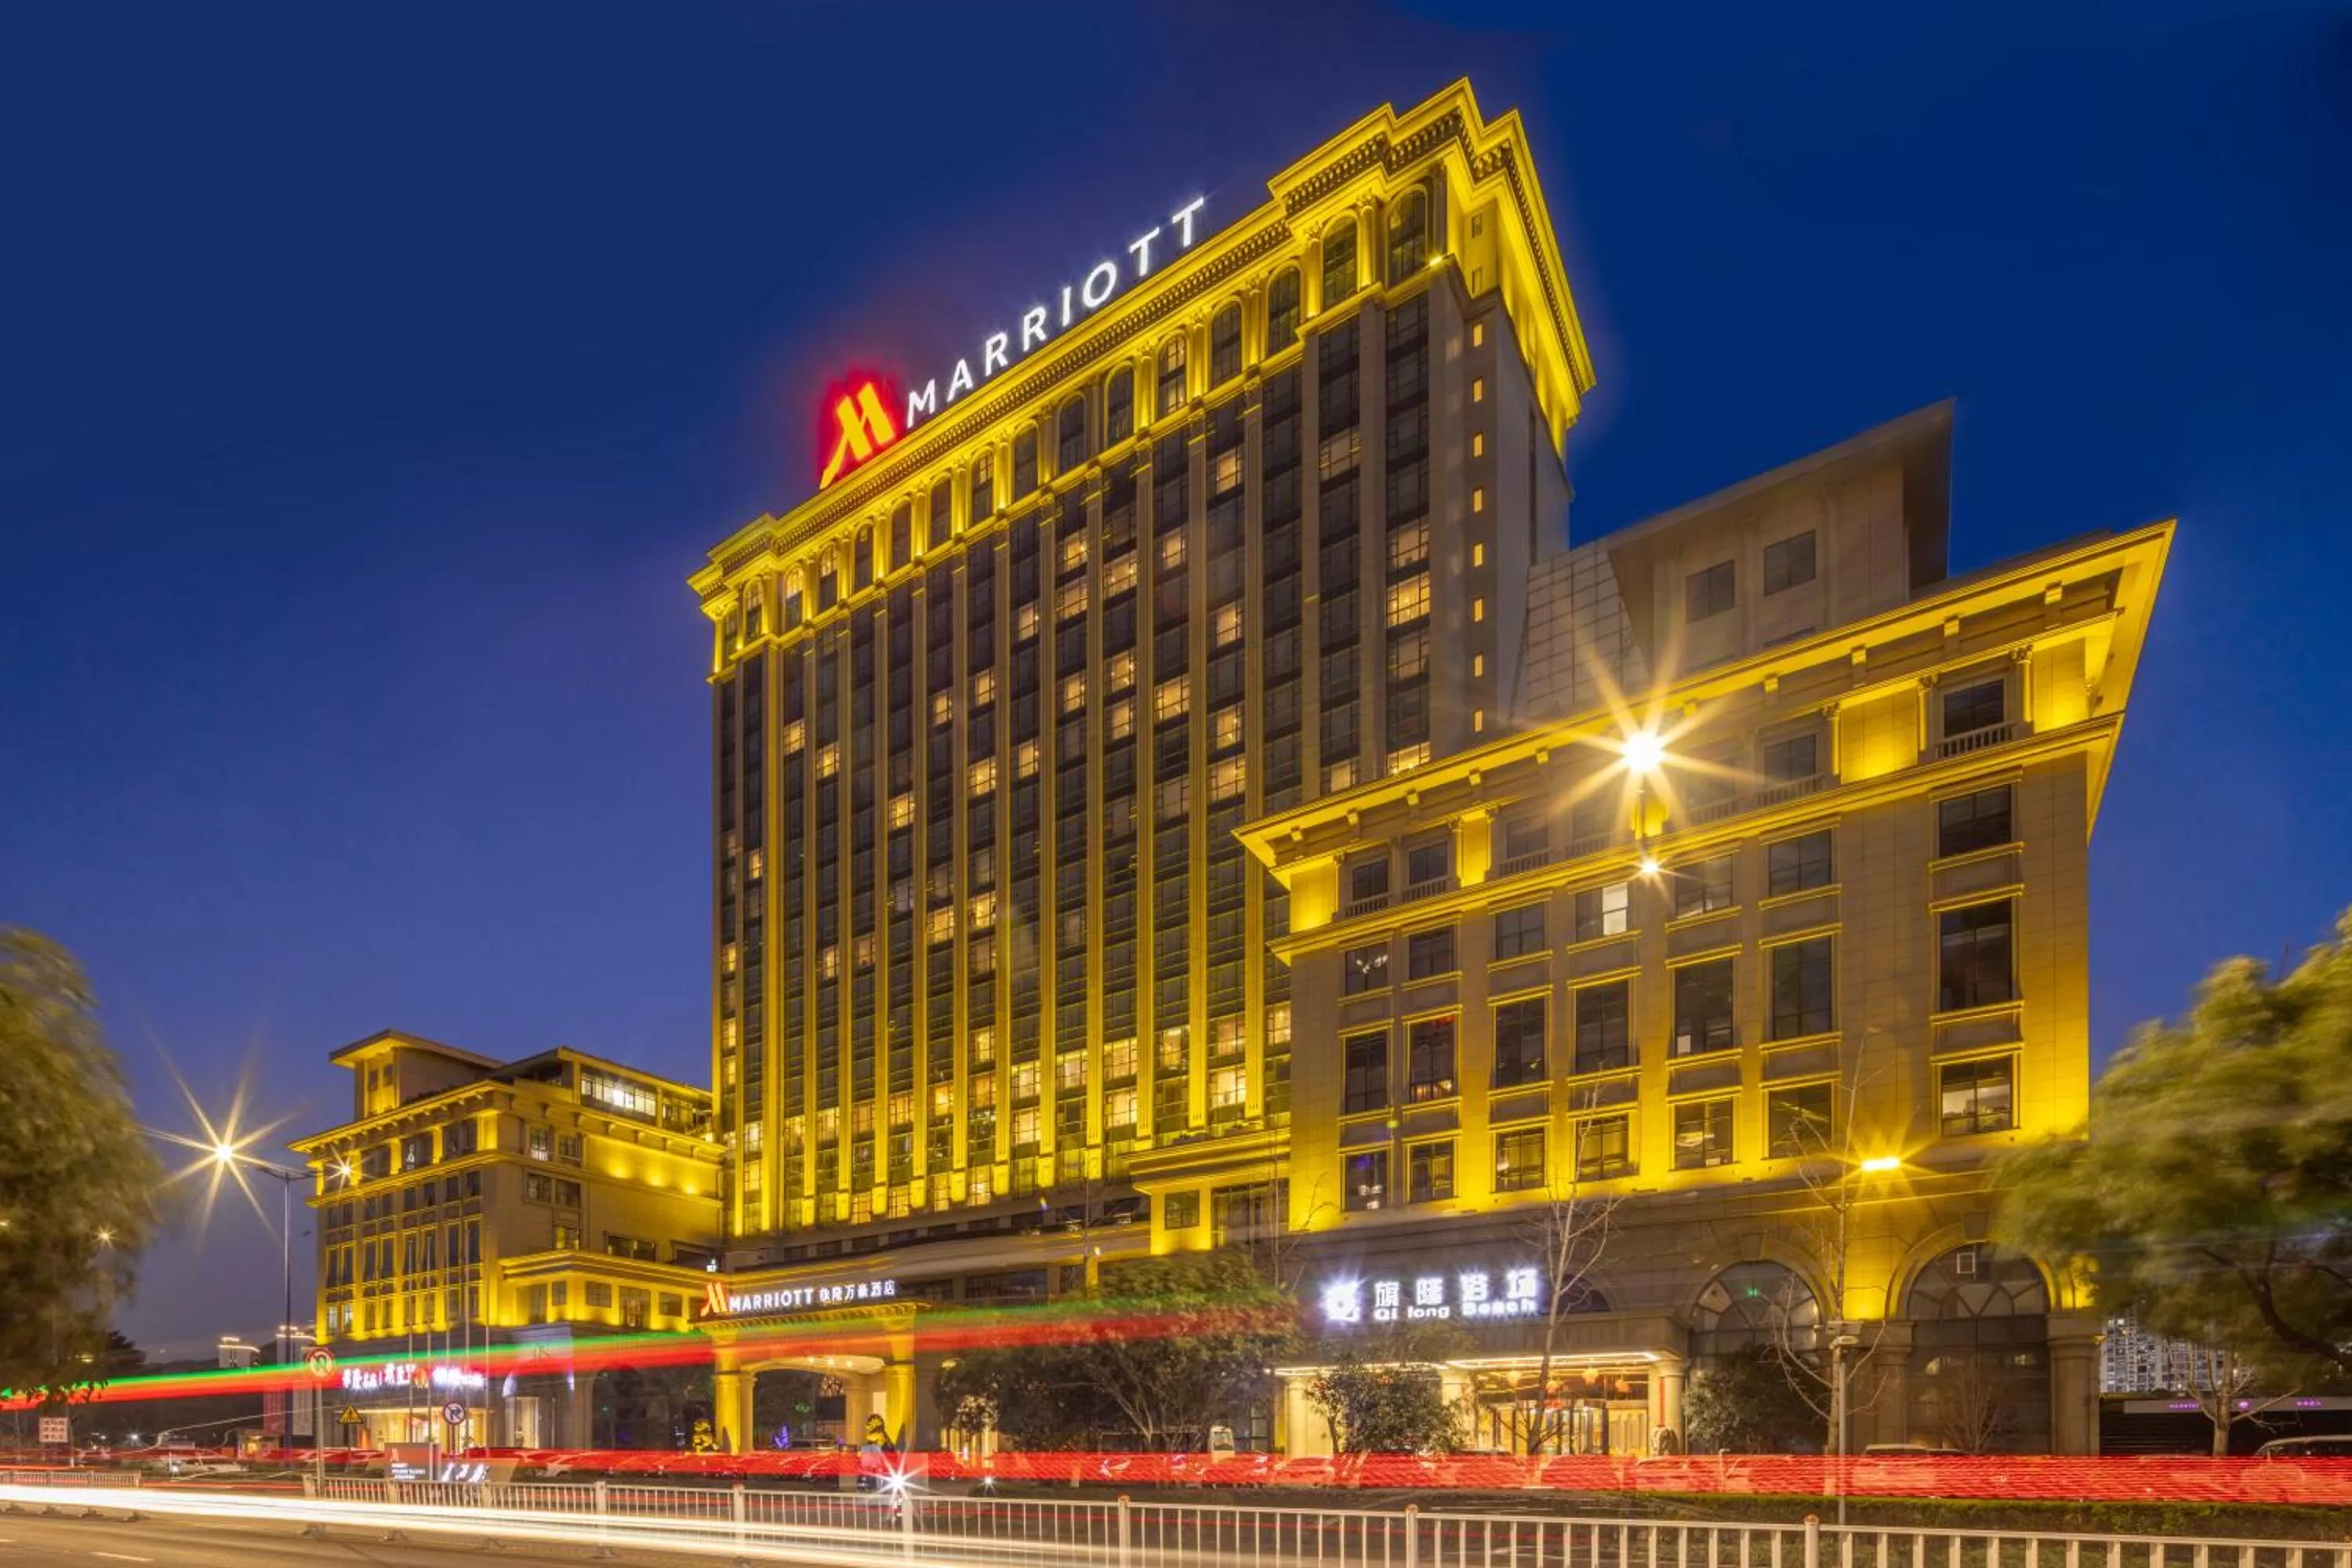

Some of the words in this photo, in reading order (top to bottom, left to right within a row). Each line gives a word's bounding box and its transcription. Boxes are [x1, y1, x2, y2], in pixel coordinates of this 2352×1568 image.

[906, 197, 1205, 428] MARRIOTT
[729, 1287, 815, 1312] MARRIOTT
[1374, 1307, 1397, 1320] Qi
[1407, 1305, 1450, 1319] long
[1462, 1299, 1536, 1316] Beach
